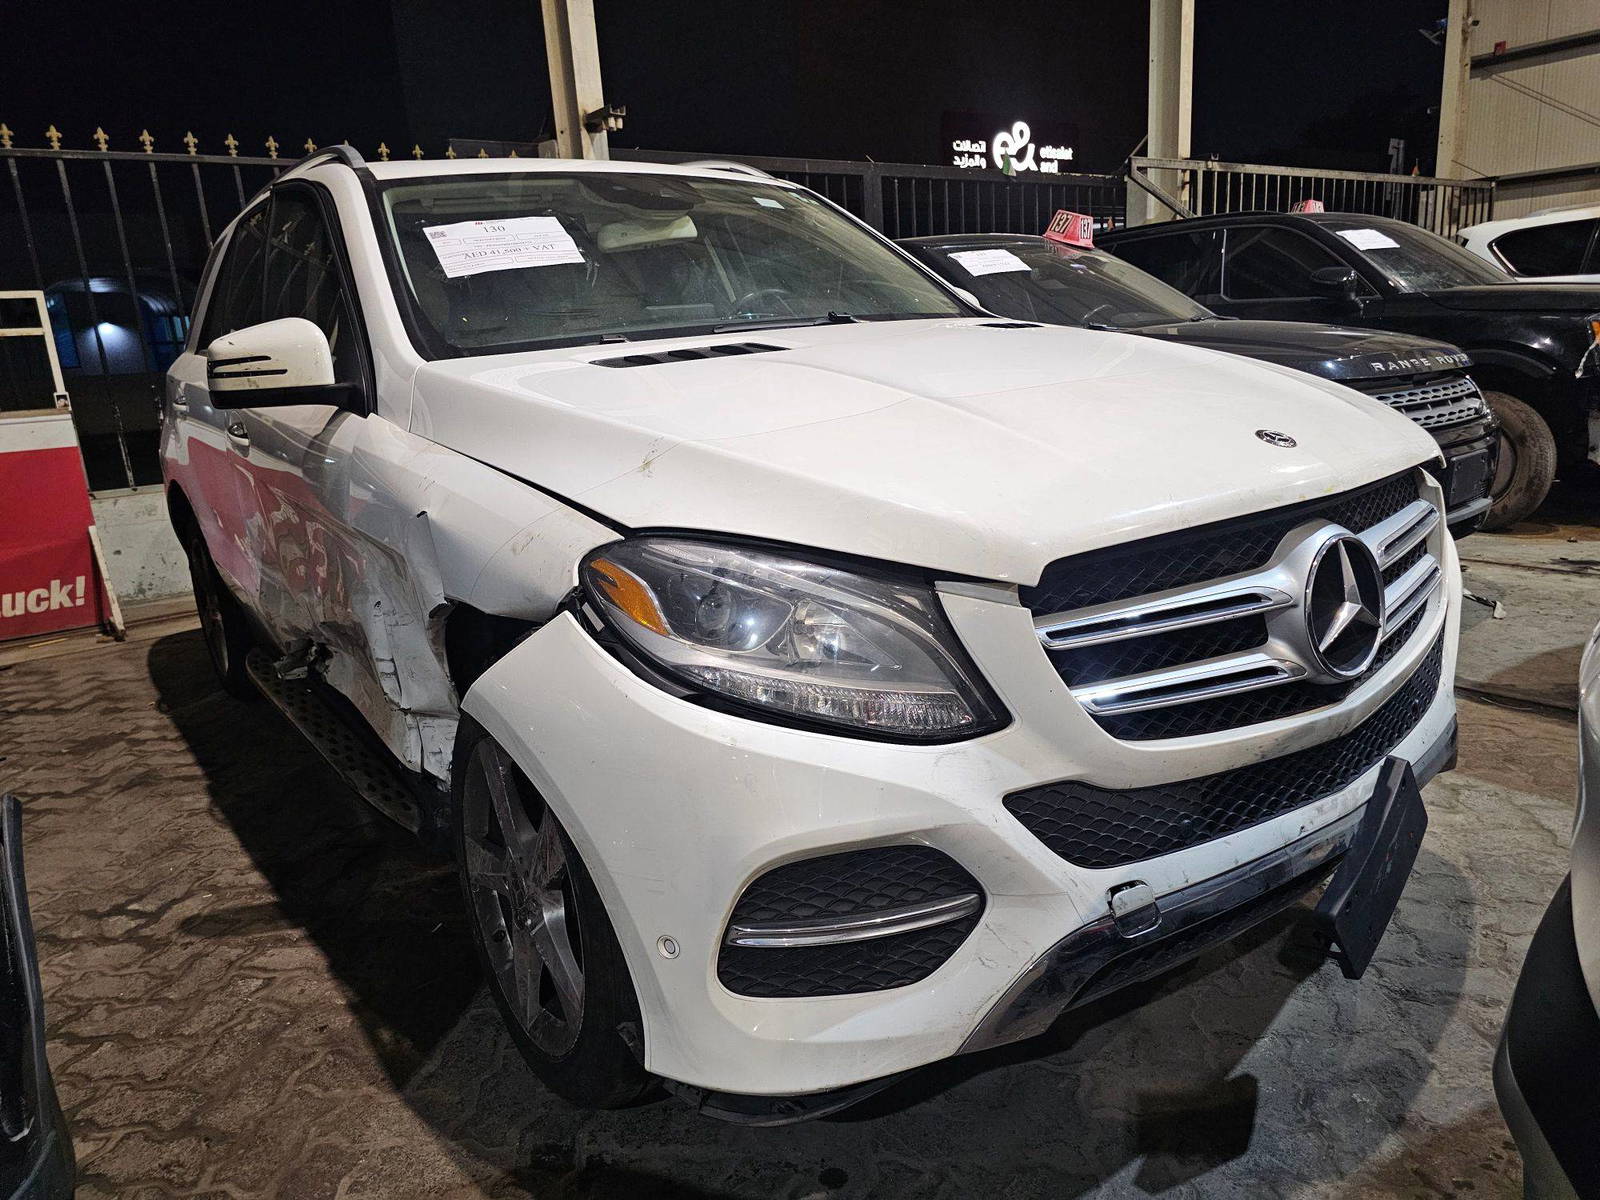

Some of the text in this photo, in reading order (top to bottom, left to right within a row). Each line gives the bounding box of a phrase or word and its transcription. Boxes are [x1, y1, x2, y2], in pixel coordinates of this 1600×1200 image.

[483, 225, 506, 233] 130
[1050, 212, 1073, 234] 137
[1080, 218, 1091, 239] 137
[463, 250, 488, 260] AED
[489, 247, 522, 257] 41,500
[531, 243, 556, 251] VAT
[1371, 358, 1431, 371] RANGE
[0, 575, 86, 618] uck!
